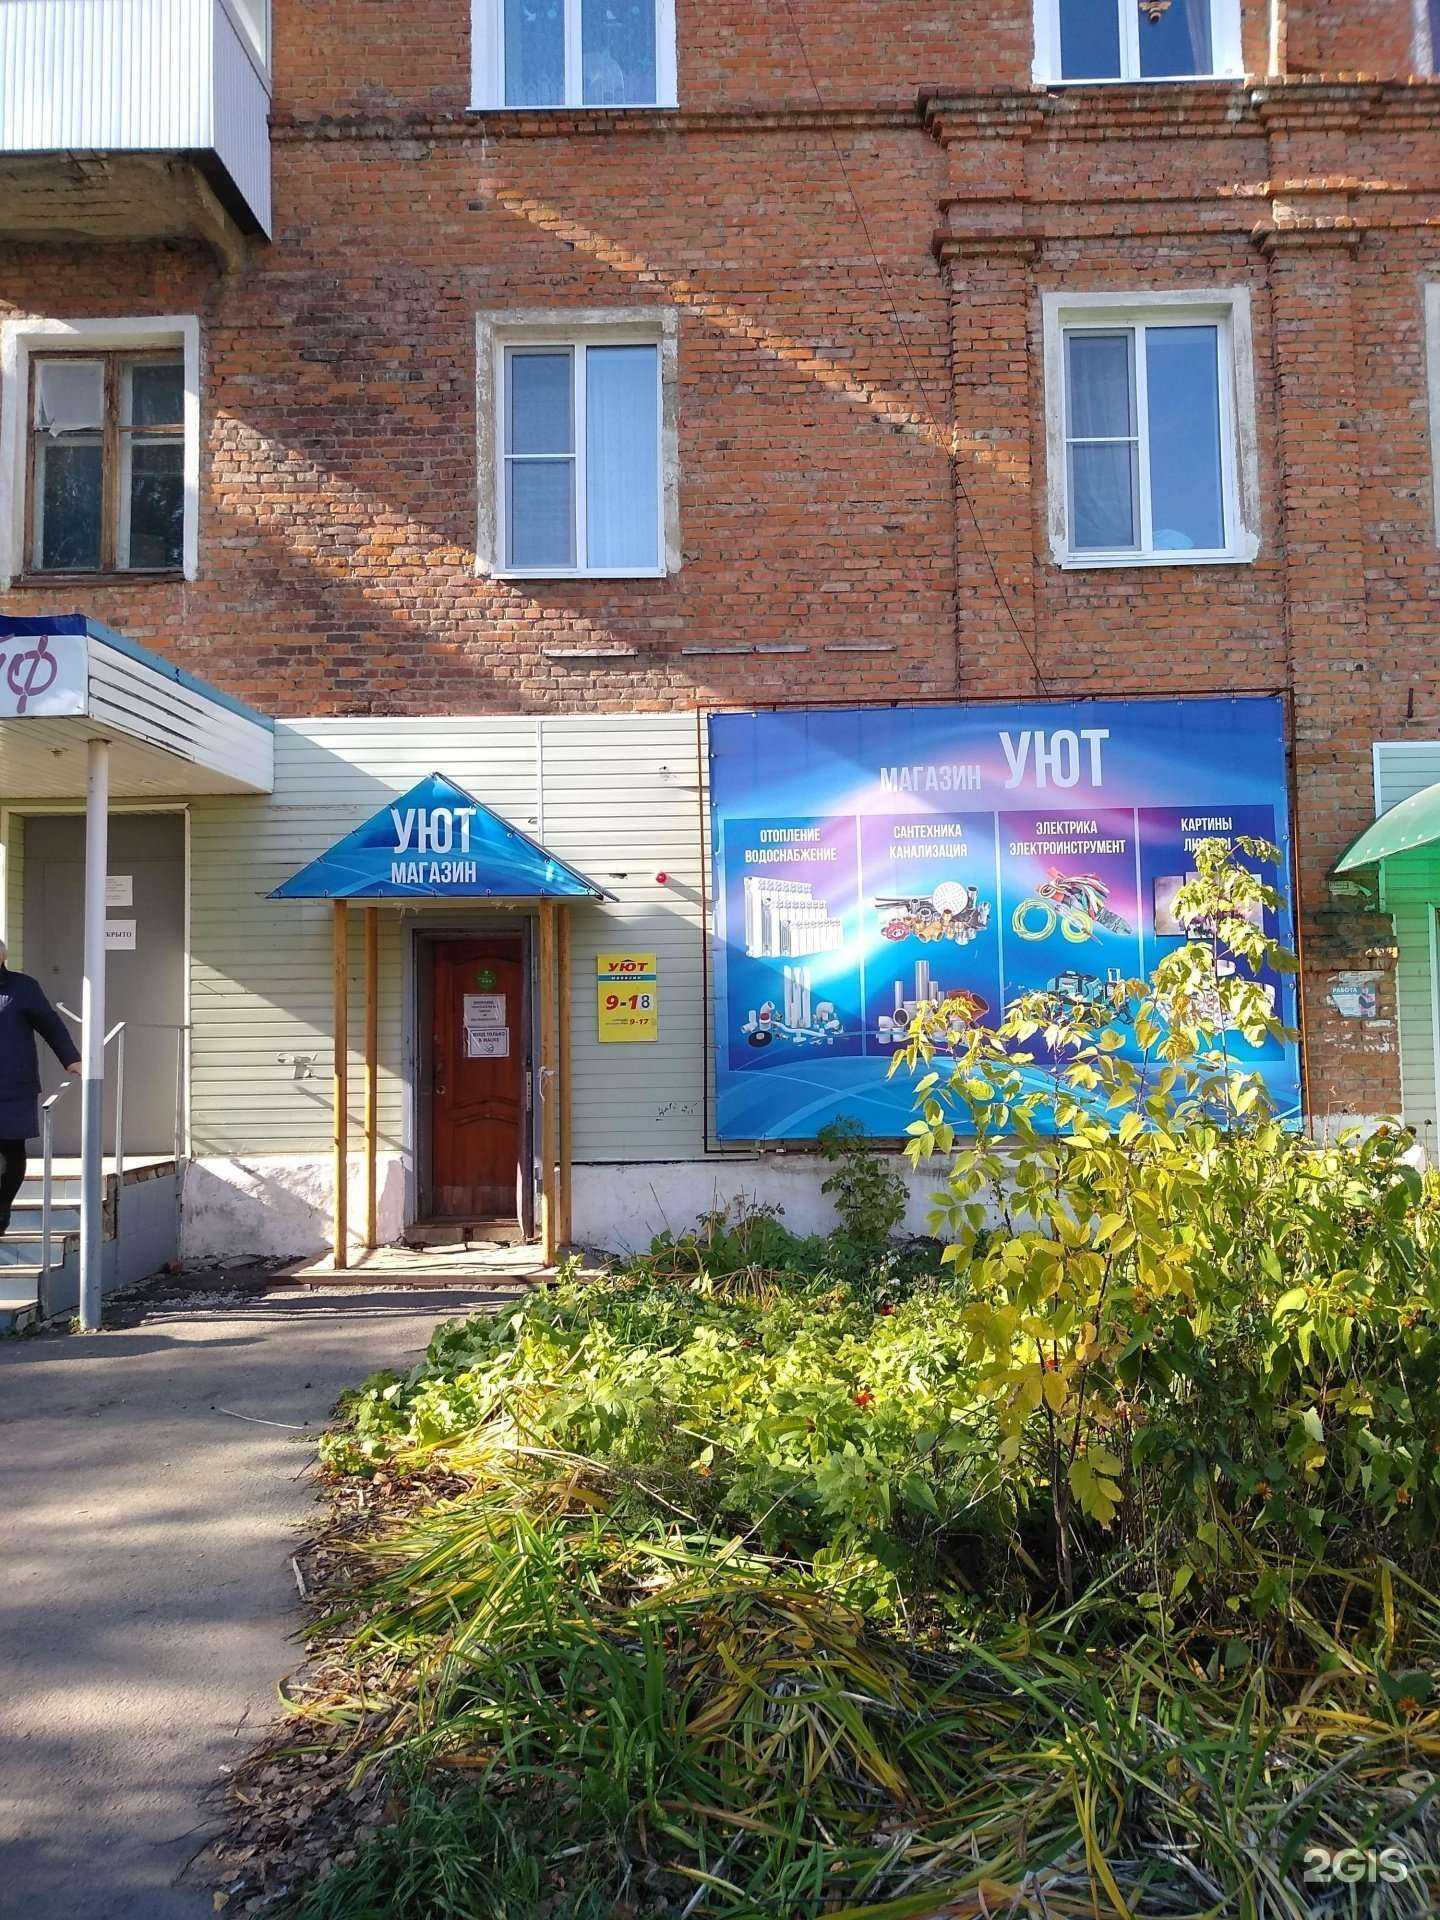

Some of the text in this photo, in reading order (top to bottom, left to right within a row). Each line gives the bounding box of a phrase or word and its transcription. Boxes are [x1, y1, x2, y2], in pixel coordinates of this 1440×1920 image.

[880, 729, 1109, 791] МАГАЗИН УЮТ
[390, 807, 476, 853] УЮТ
[894, 824, 962, 839] САНТЕХНИКА
[1036, 821, 1097, 835] ЭЛЕКТРИКА
[1181, 817, 1232, 831] КАРТИНЫ
[760, 828, 821, 842] ОТОПЛЕНИЕ
[890, 844, 968, 859] КАНАЛИЗАЦИЯ
[1010, 840, 1125, 855] ЭЛЕКТРОИНСТРУМЕНТ
[745, 848, 837, 863] ВОДОСНАБЖЕНИЕ
[391, 862, 476, 883] МАГАЗИН
[608, 962, 648, 972] УЮТ
[606, 994, 650, 1010] 9-18
